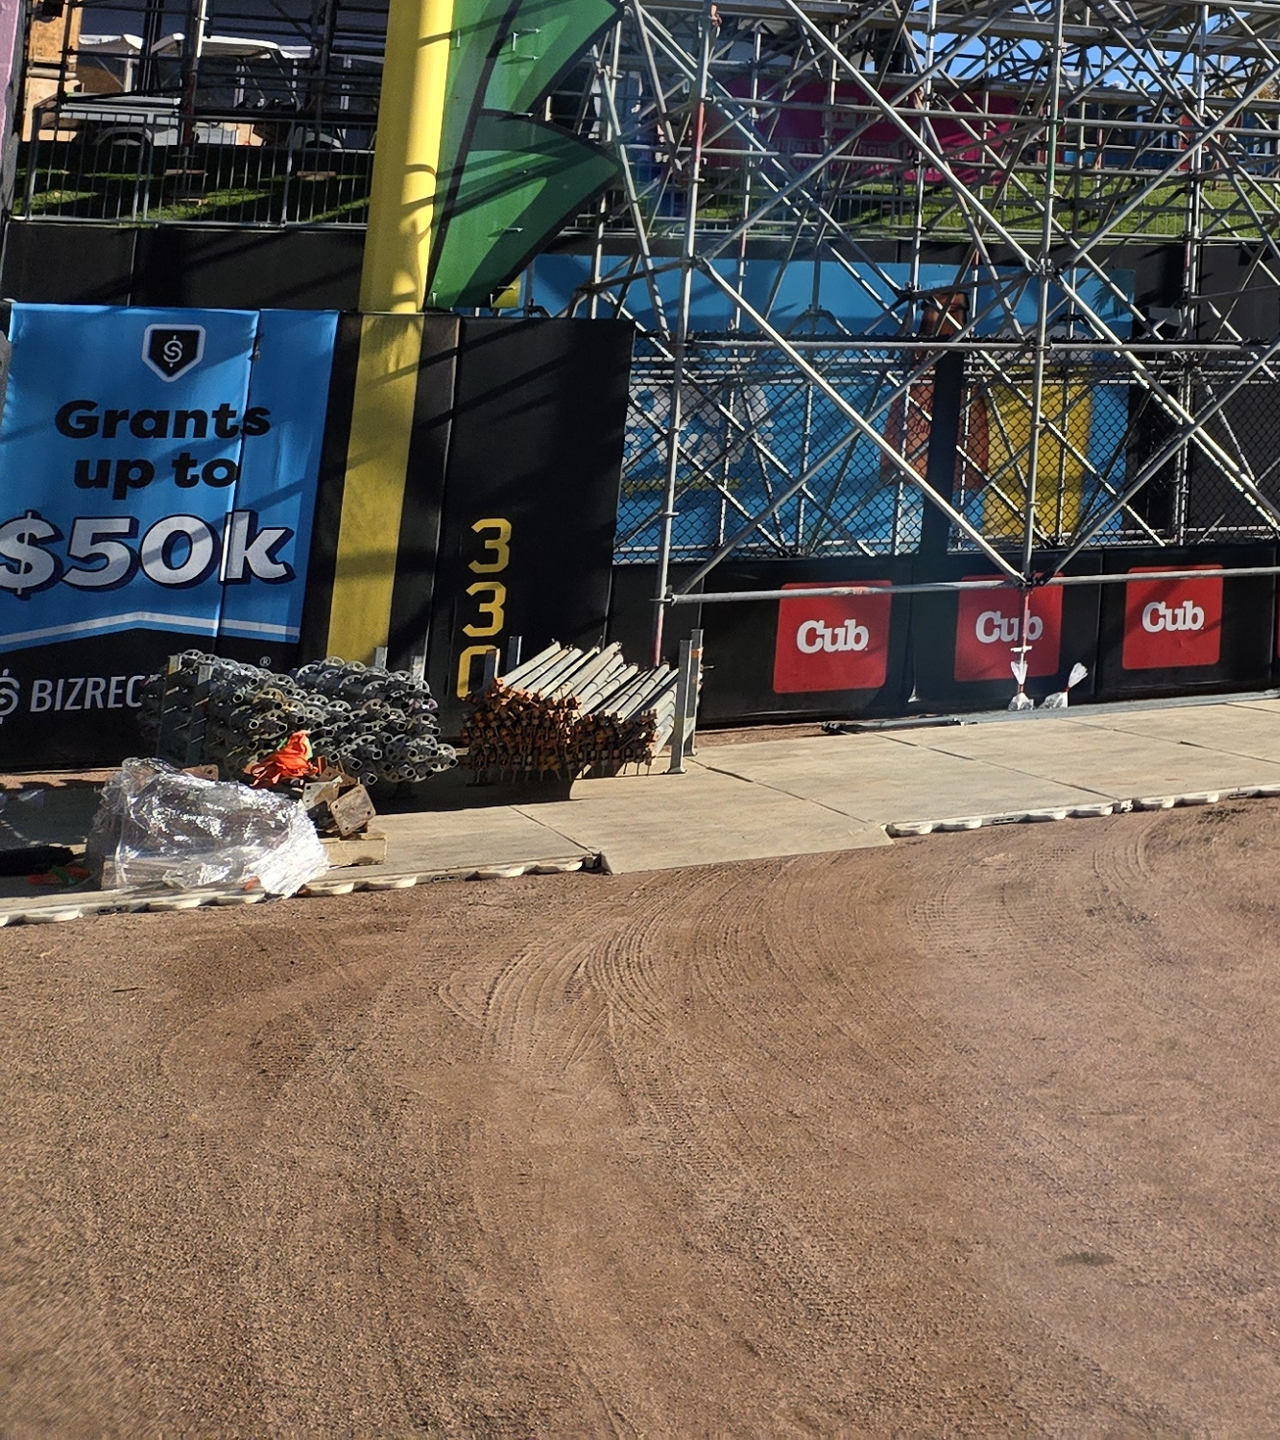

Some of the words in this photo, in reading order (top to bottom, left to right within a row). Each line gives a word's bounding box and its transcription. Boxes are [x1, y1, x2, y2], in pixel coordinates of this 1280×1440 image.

[54, 399, 271, 439] Grants
[74, 458, 155, 501] up
[171, 451, 239, 489] to
[0, 509, 291, 596] $50k
[975, 610, 1043, 643] Cub
[1141, 600, 1205, 633] Cub
[796, 619, 869, 654] Cub
[29, 675, 148, 713] BIZREC
